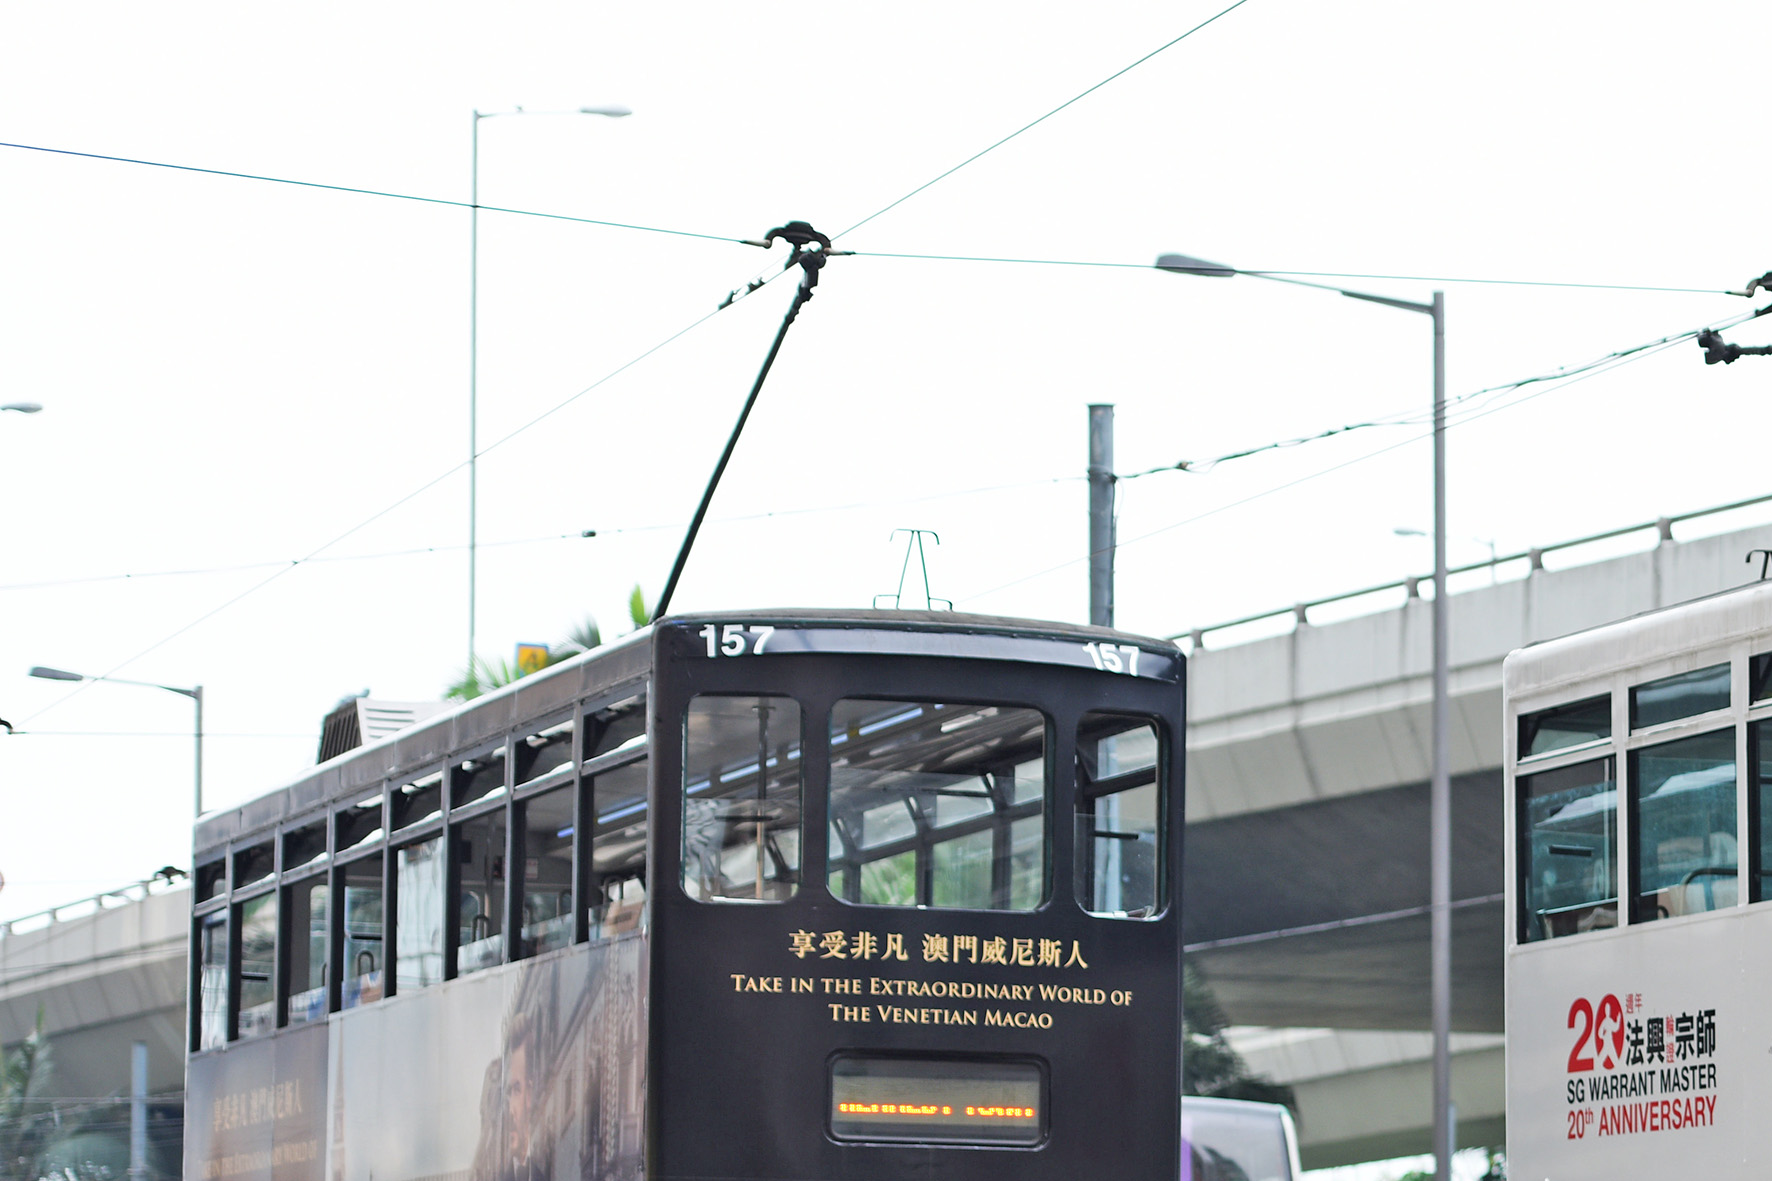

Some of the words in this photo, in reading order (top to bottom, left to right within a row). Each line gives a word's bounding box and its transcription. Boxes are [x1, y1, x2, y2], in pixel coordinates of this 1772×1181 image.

[699, 624, 774, 658] 157
[1083, 641, 1141, 677] 157
[788, 929, 909, 963] 享受非凡
[921, 932, 1089, 970] 澳門威尼斯人
[730, 973, 784, 994] TAKE
[790, 977, 815, 994] IN
[821, 977, 863, 996] THE
[870, 976, 1035, 1002] EXTRAORDINARY
[1038, 983, 1106, 1006] WORLD
[1110, 990, 1133, 1007] OF
[828, 1003, 872, 1023] THE
[877, 1004, 978, 1027] VENETIAN
[984, 1009, 1054, 1030] MACAO
[1566, 1077, 1585, 1104] SG
[1588, 1070, 1656, 1102] WARRANT
[1659, 1063, 1717, 1094] MASTER
[1567, 1106, 1594, 1140] 20th
[1598, 1094, 1717, 1137] ANNIVERSARY
